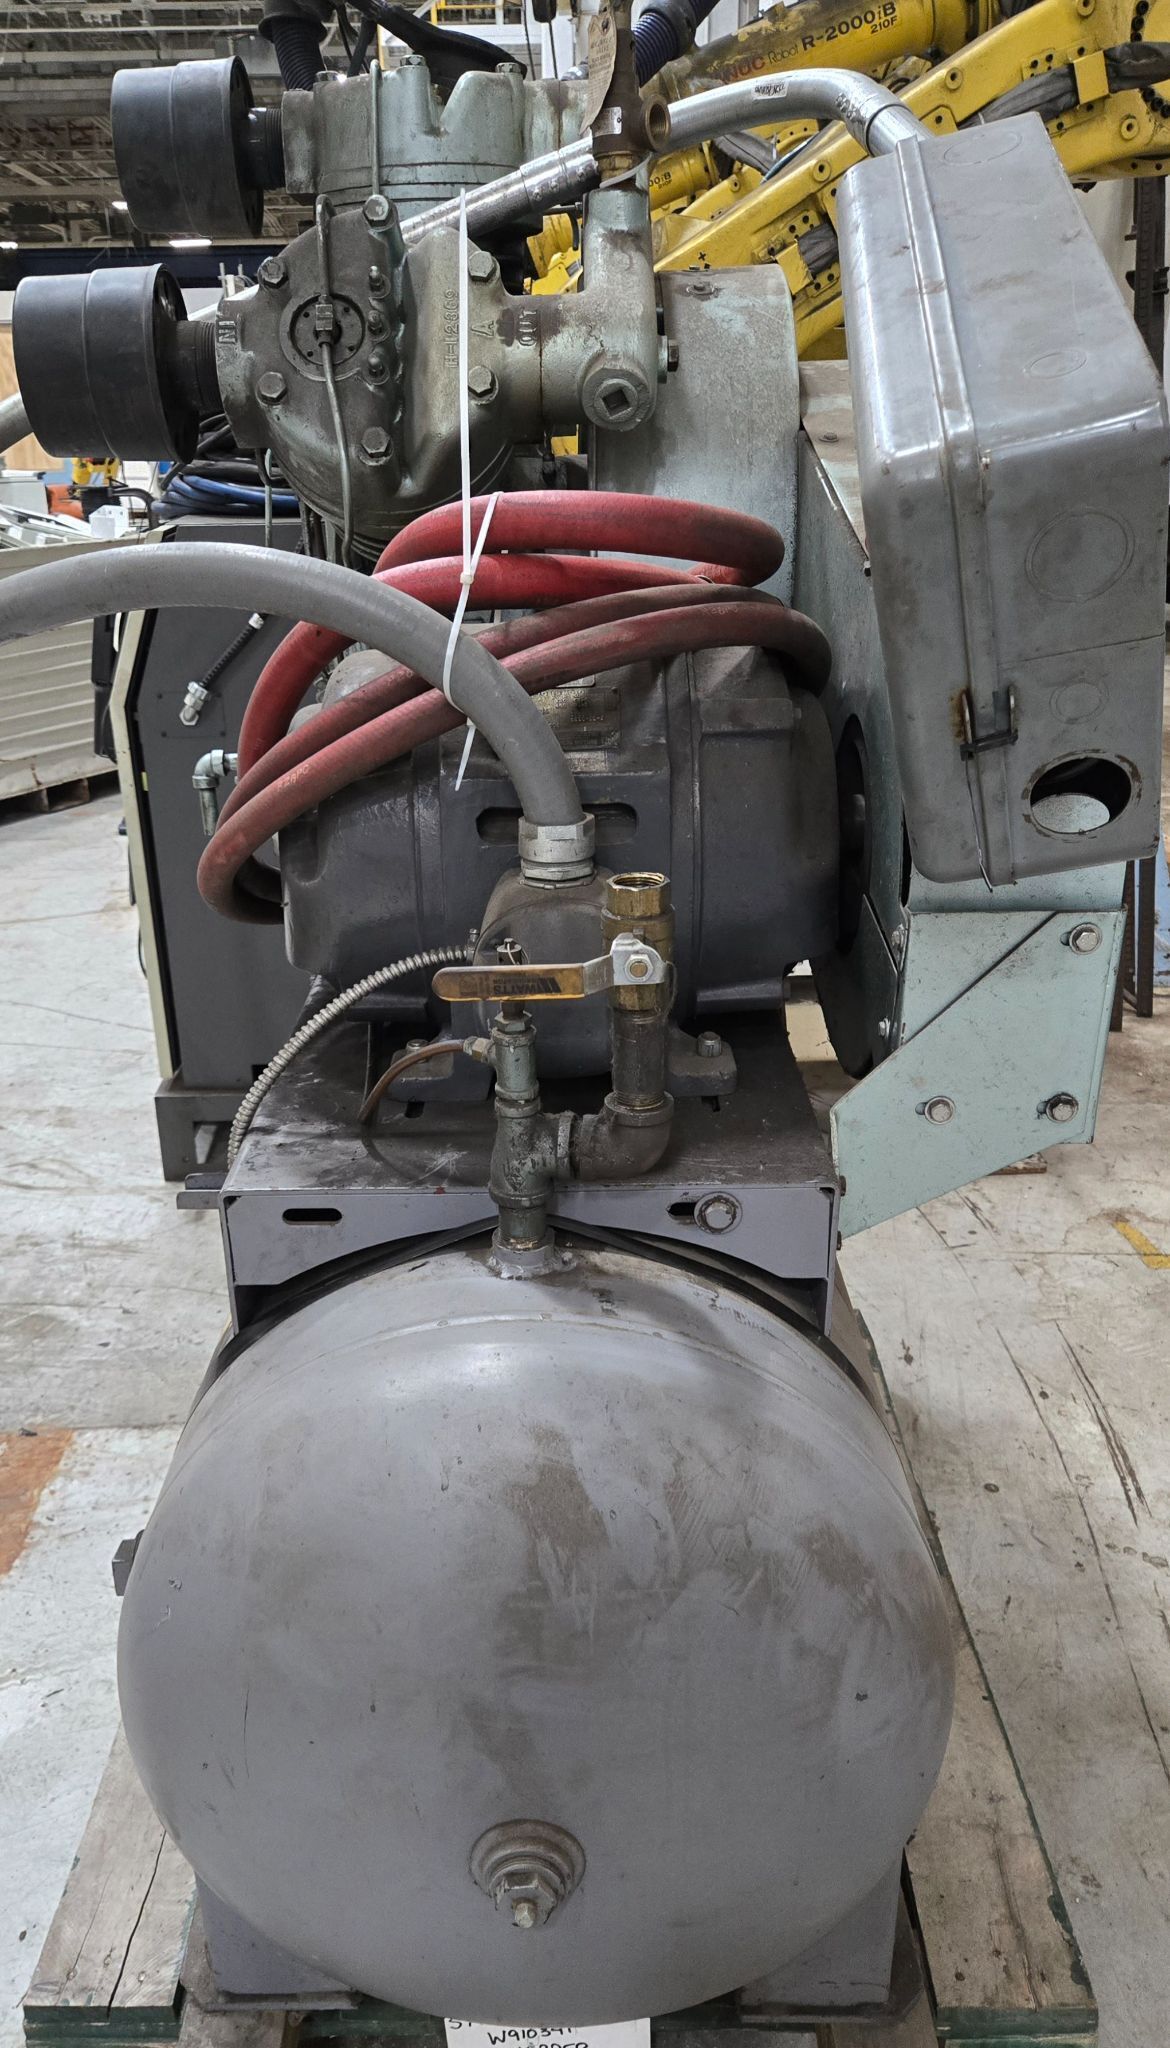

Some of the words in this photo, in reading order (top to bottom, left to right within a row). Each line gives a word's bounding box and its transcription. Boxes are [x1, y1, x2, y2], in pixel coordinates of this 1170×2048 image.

[768, 44, 799, 64] Robot
[801, 1, 896, 51] R-2000iB
[870, 15, 898, 35] 210F
[218, 320, 236, 344] IN
[519, 310, 537, 346] OUT
